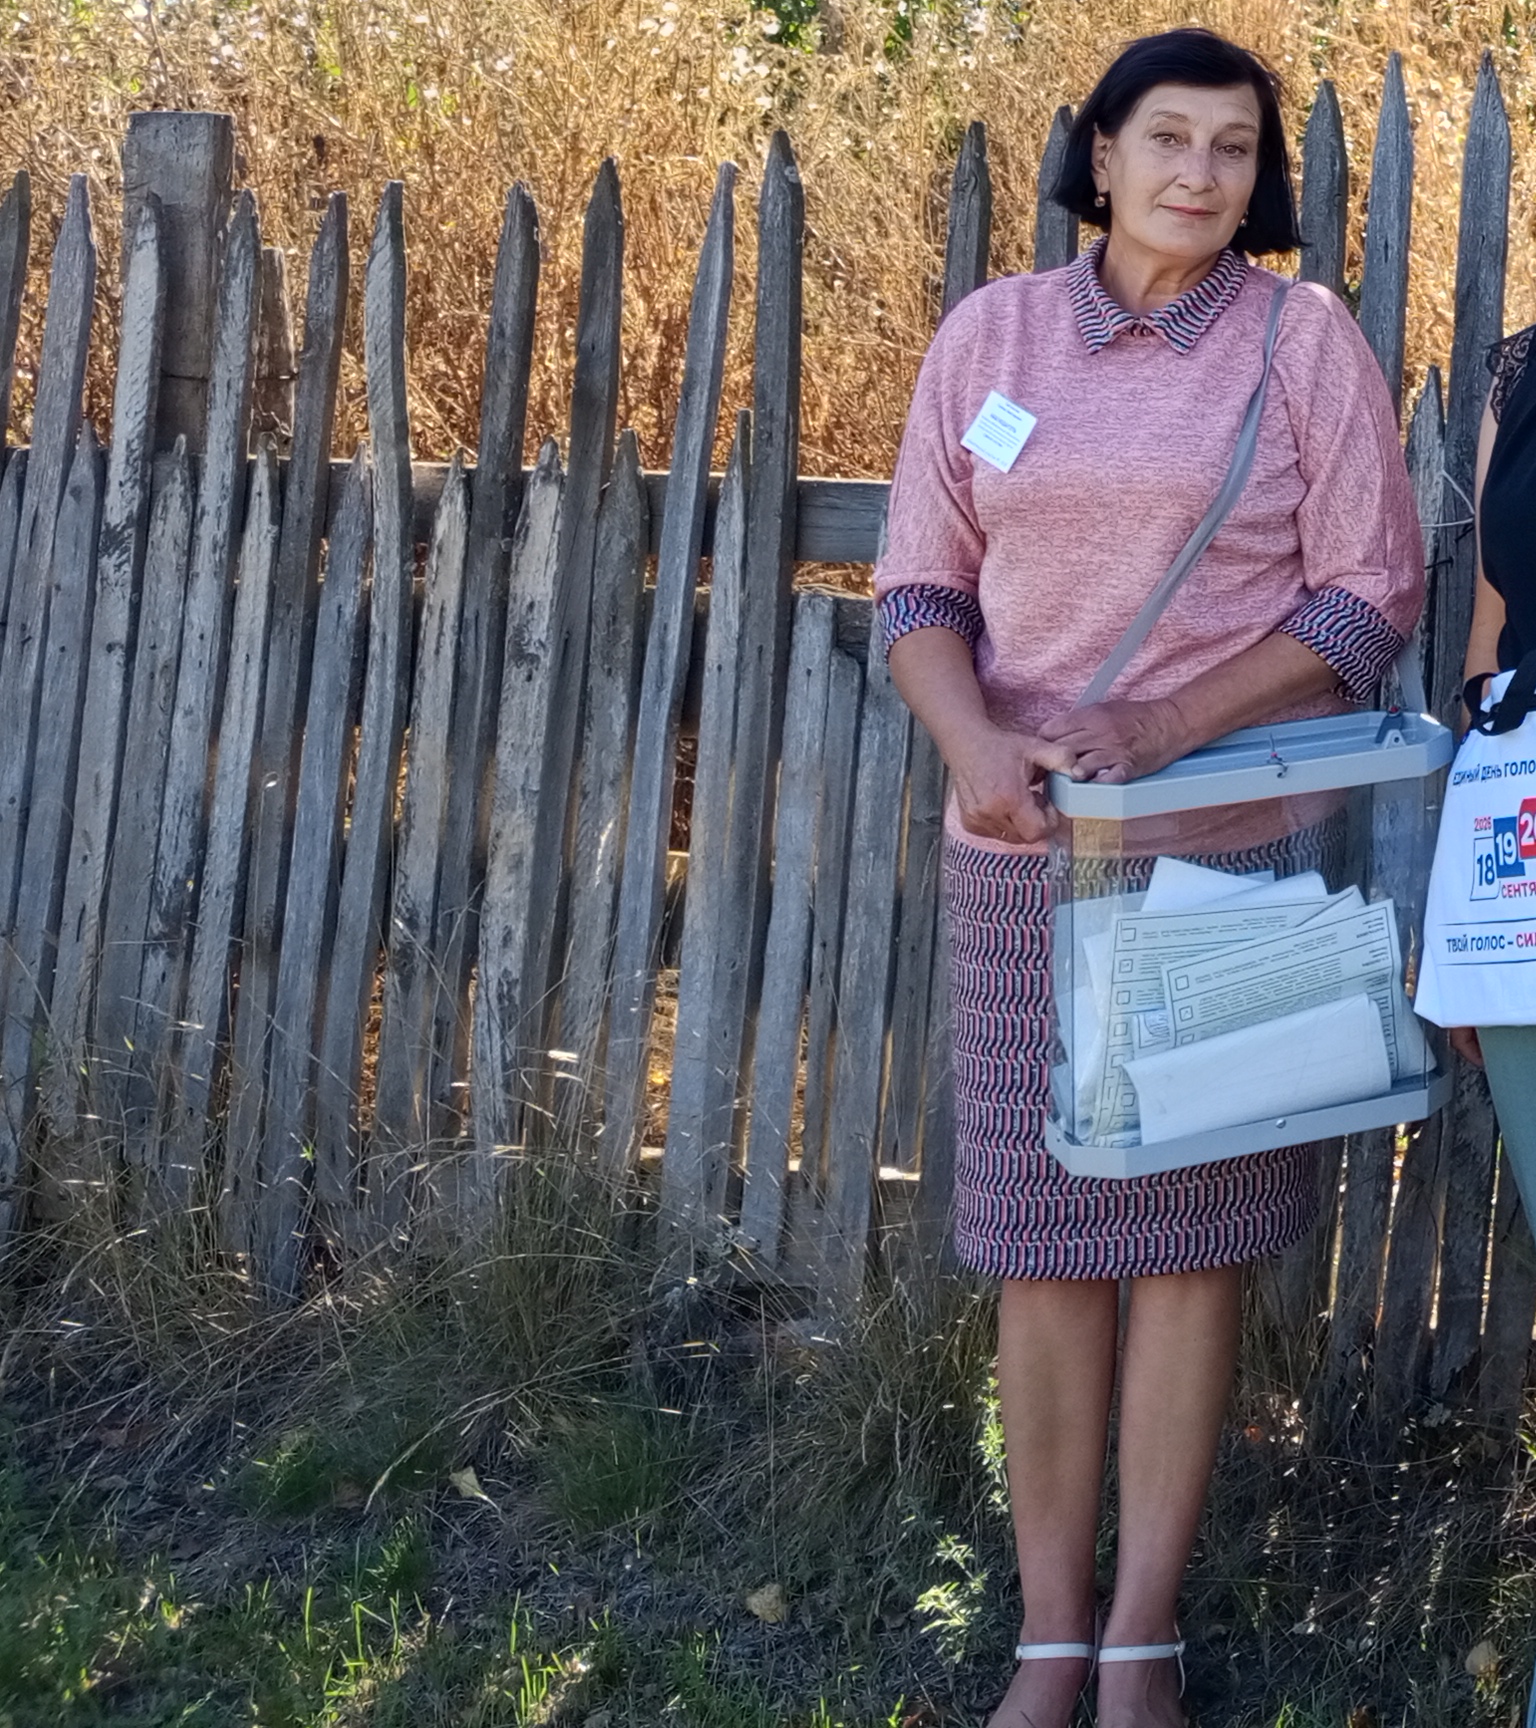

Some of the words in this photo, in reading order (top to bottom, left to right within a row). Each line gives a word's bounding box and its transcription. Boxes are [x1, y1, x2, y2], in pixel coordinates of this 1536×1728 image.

[1496, 831, 1517, 866] 19
[1476, 853, 1495, 886] 18
[1446, 934, 1469, 953] ТВОЙ
[1470, 934, 1506, 952] ГОЛОС
